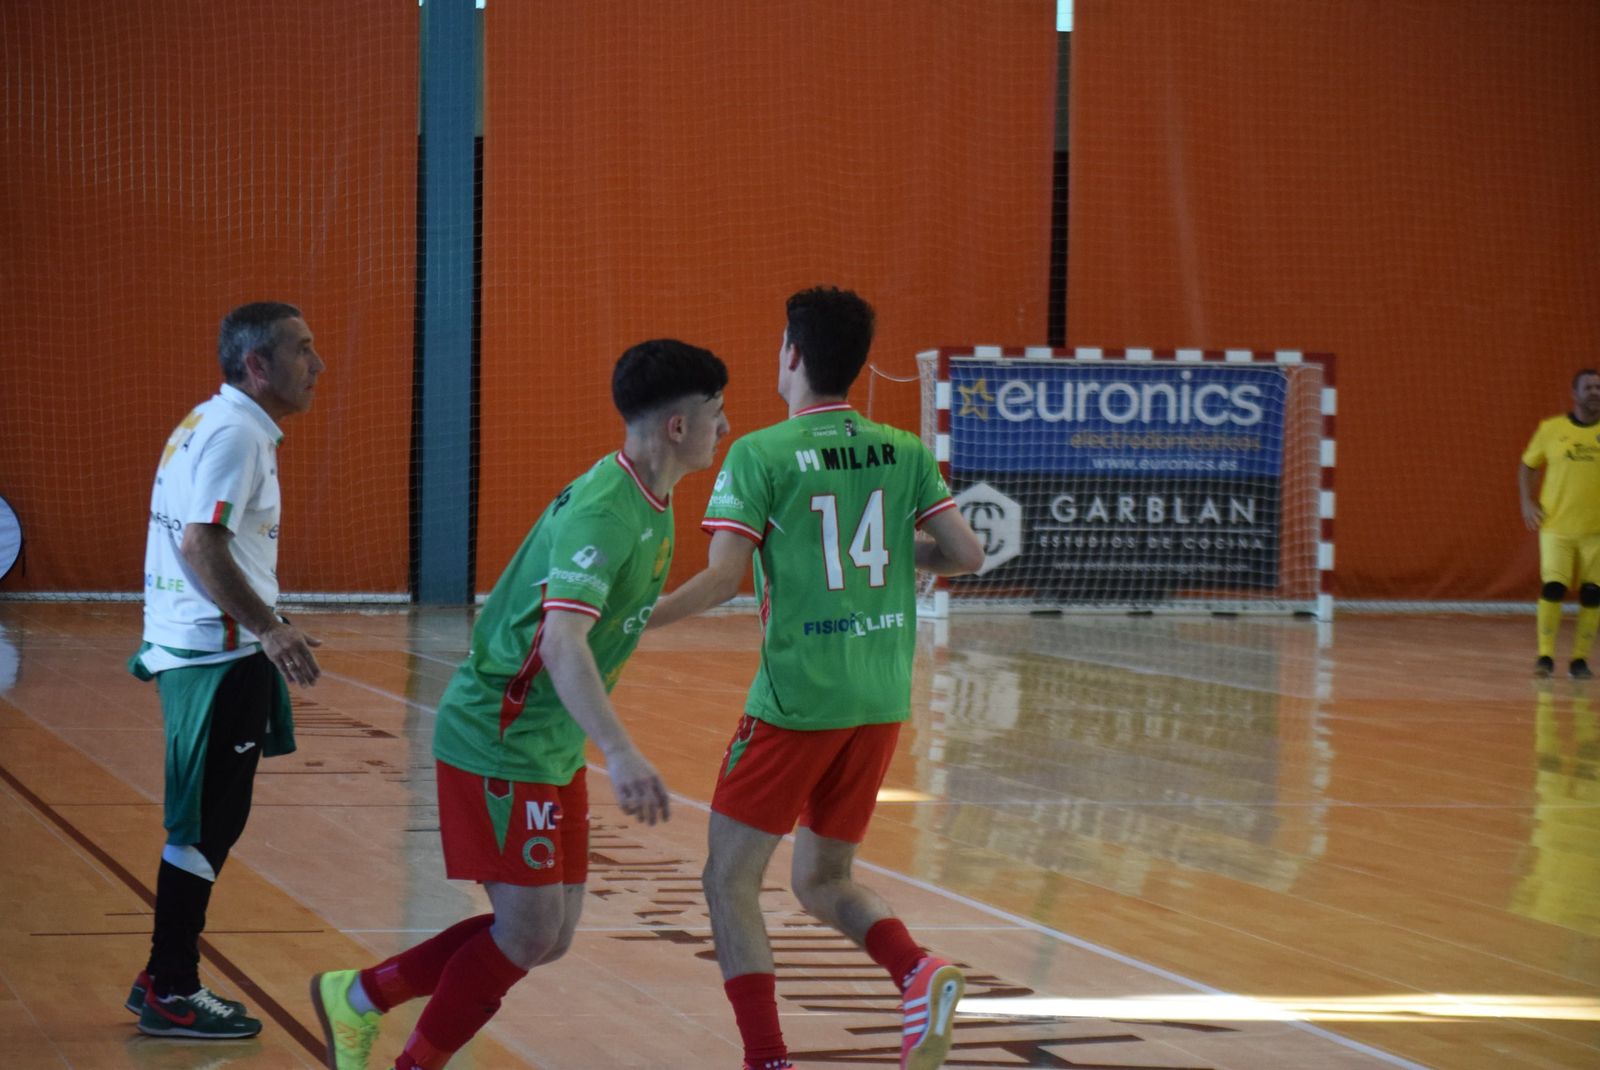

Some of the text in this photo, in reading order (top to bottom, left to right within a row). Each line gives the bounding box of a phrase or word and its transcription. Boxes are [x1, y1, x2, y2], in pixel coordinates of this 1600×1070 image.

[996, 370, 1263, 426] euronics
[821, 443, 897, 471] MILAR
[1092, 455, 1238, 471] www.euronics.es
[1050, 495, 1256, 525] GARBLAN
[810, 489, 889, 591] 14
[1039, 535, 1265, 551] ESTUDIOS DE COCINA
